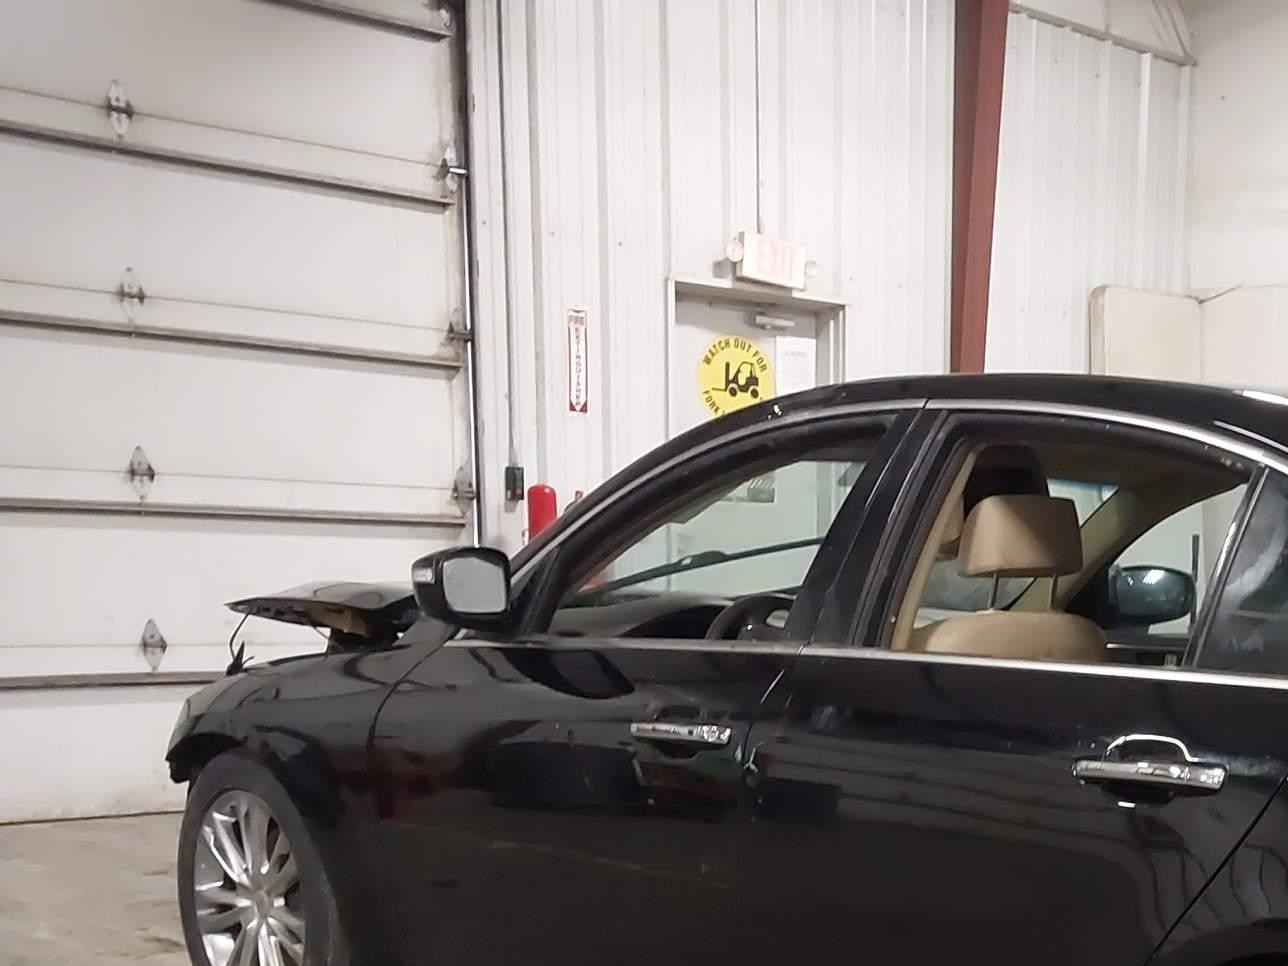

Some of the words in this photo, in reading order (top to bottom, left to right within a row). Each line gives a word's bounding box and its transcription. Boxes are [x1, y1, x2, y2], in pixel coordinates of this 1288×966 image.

[756, 238, 797, 282] EXIT
[568, 314, 585, 326] FIRE
[703, 338, 731, 366] WATCH
[734, 339, 752, 353] OUT
[752, 350, 768, 373] FOR
